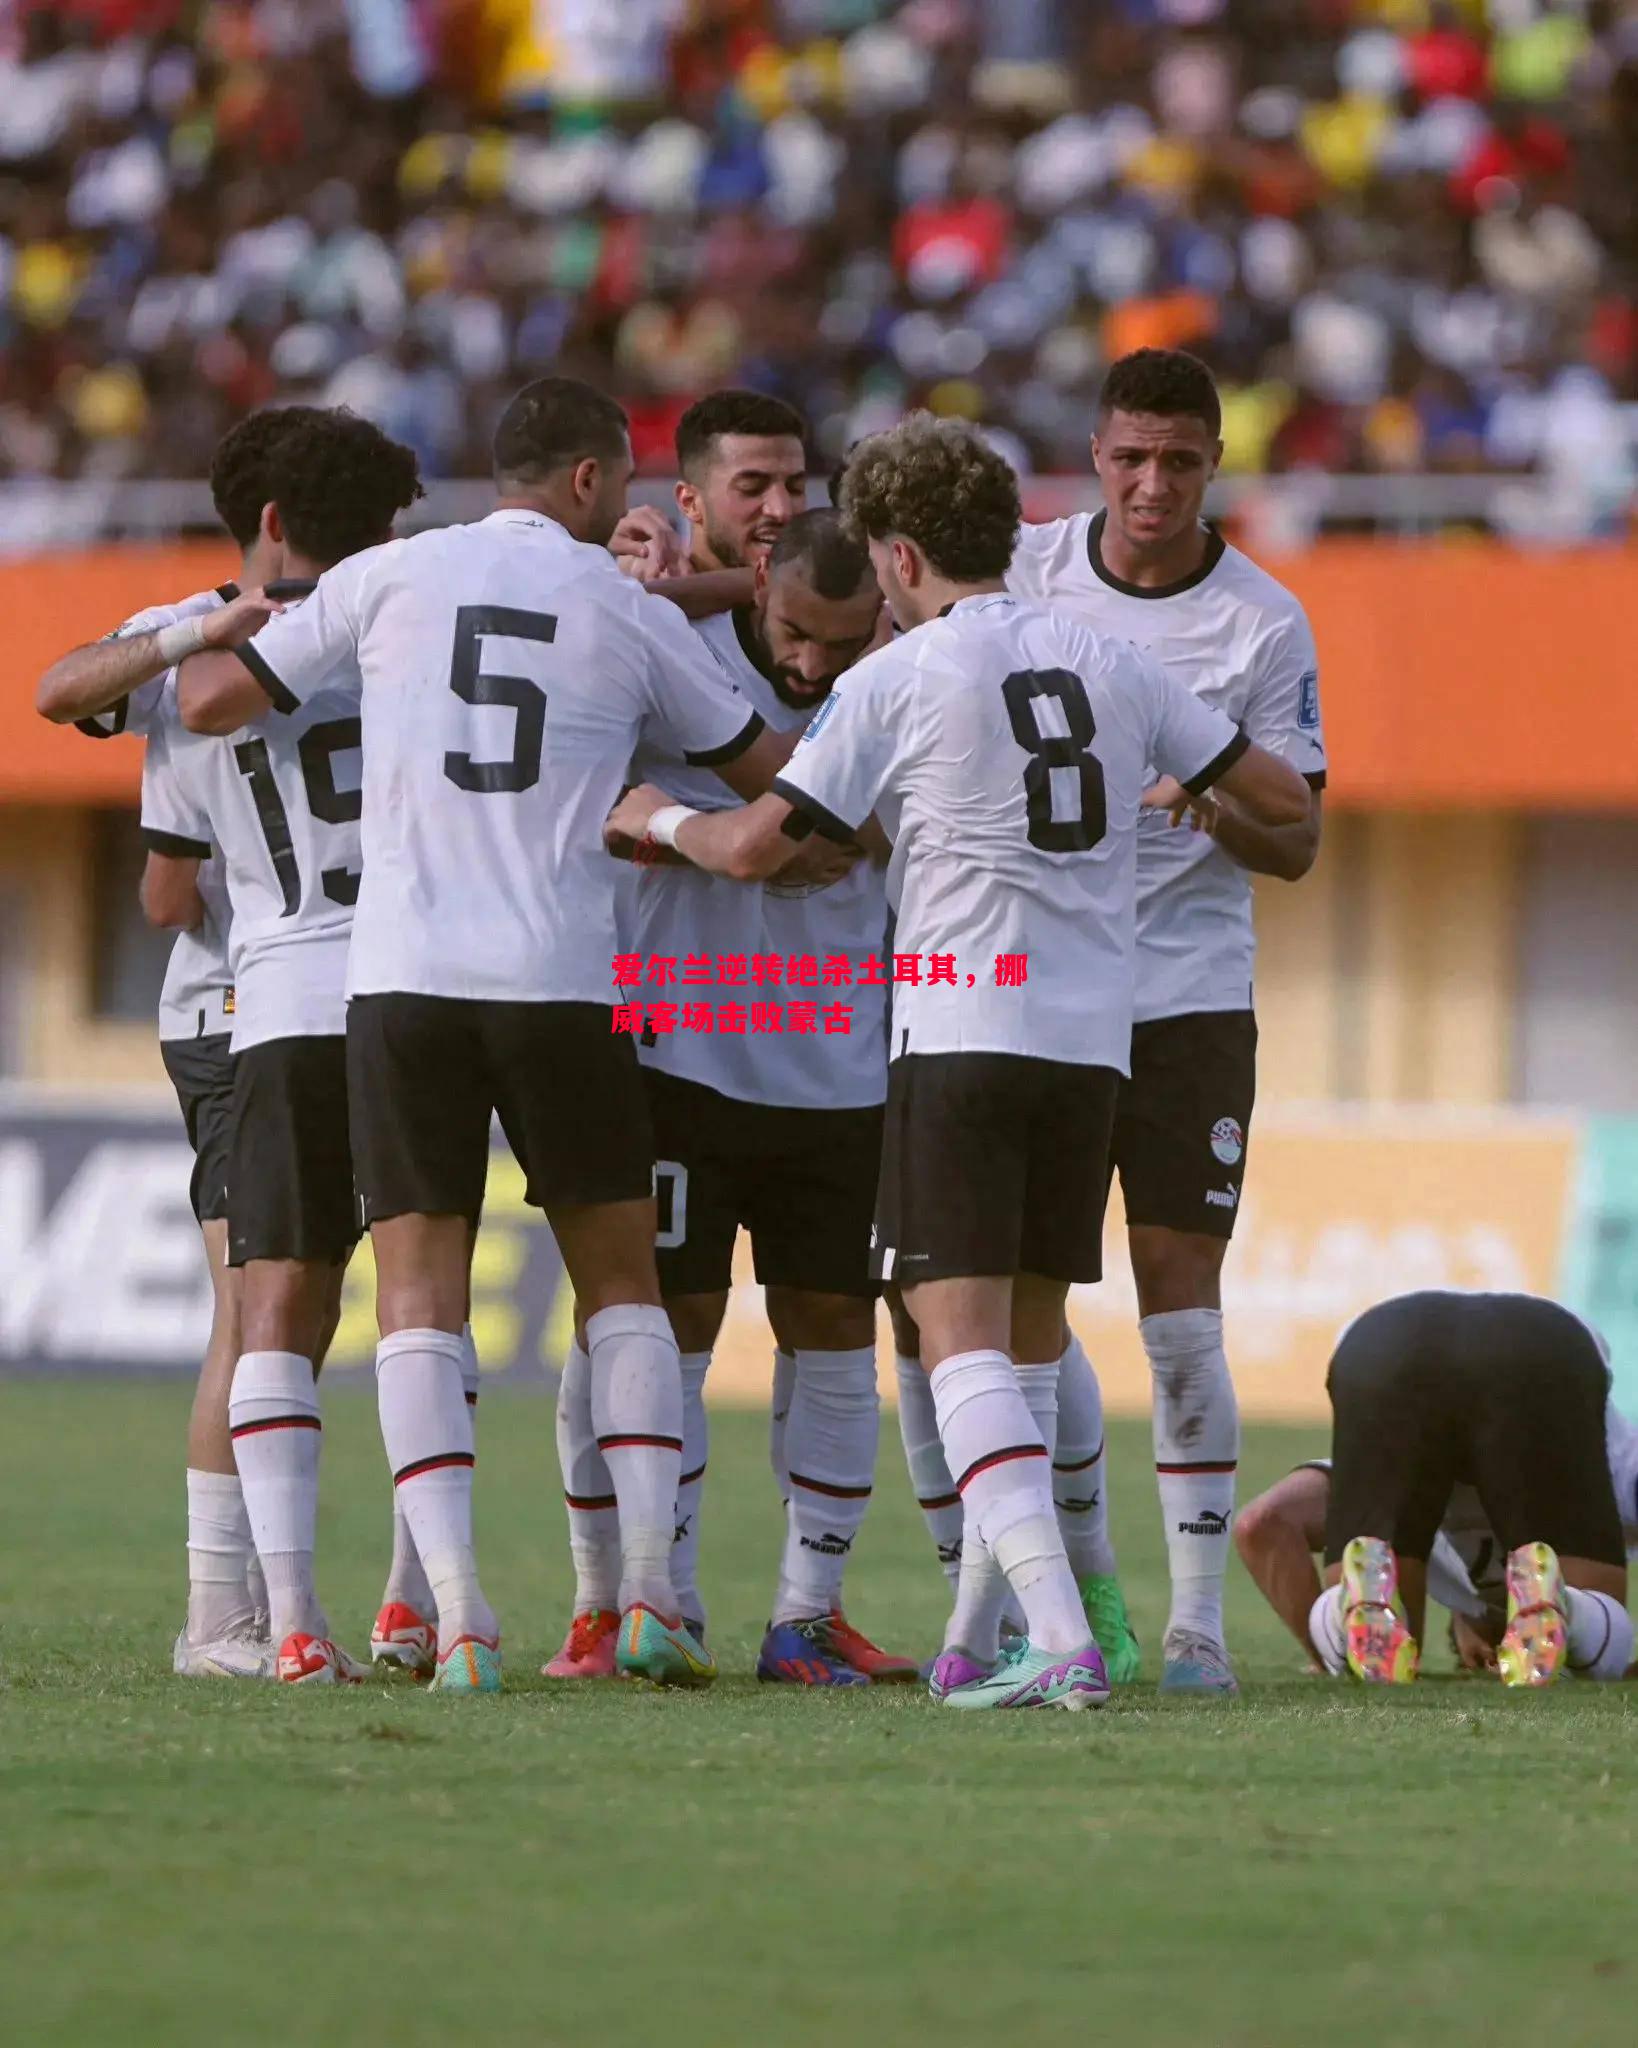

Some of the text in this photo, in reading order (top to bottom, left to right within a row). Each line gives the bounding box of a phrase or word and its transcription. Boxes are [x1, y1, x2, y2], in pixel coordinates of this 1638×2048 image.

[444, 605, 558, 793] 5
[1002, 667, 1107, 853] 8
[234, 716, 362, 918] 19
